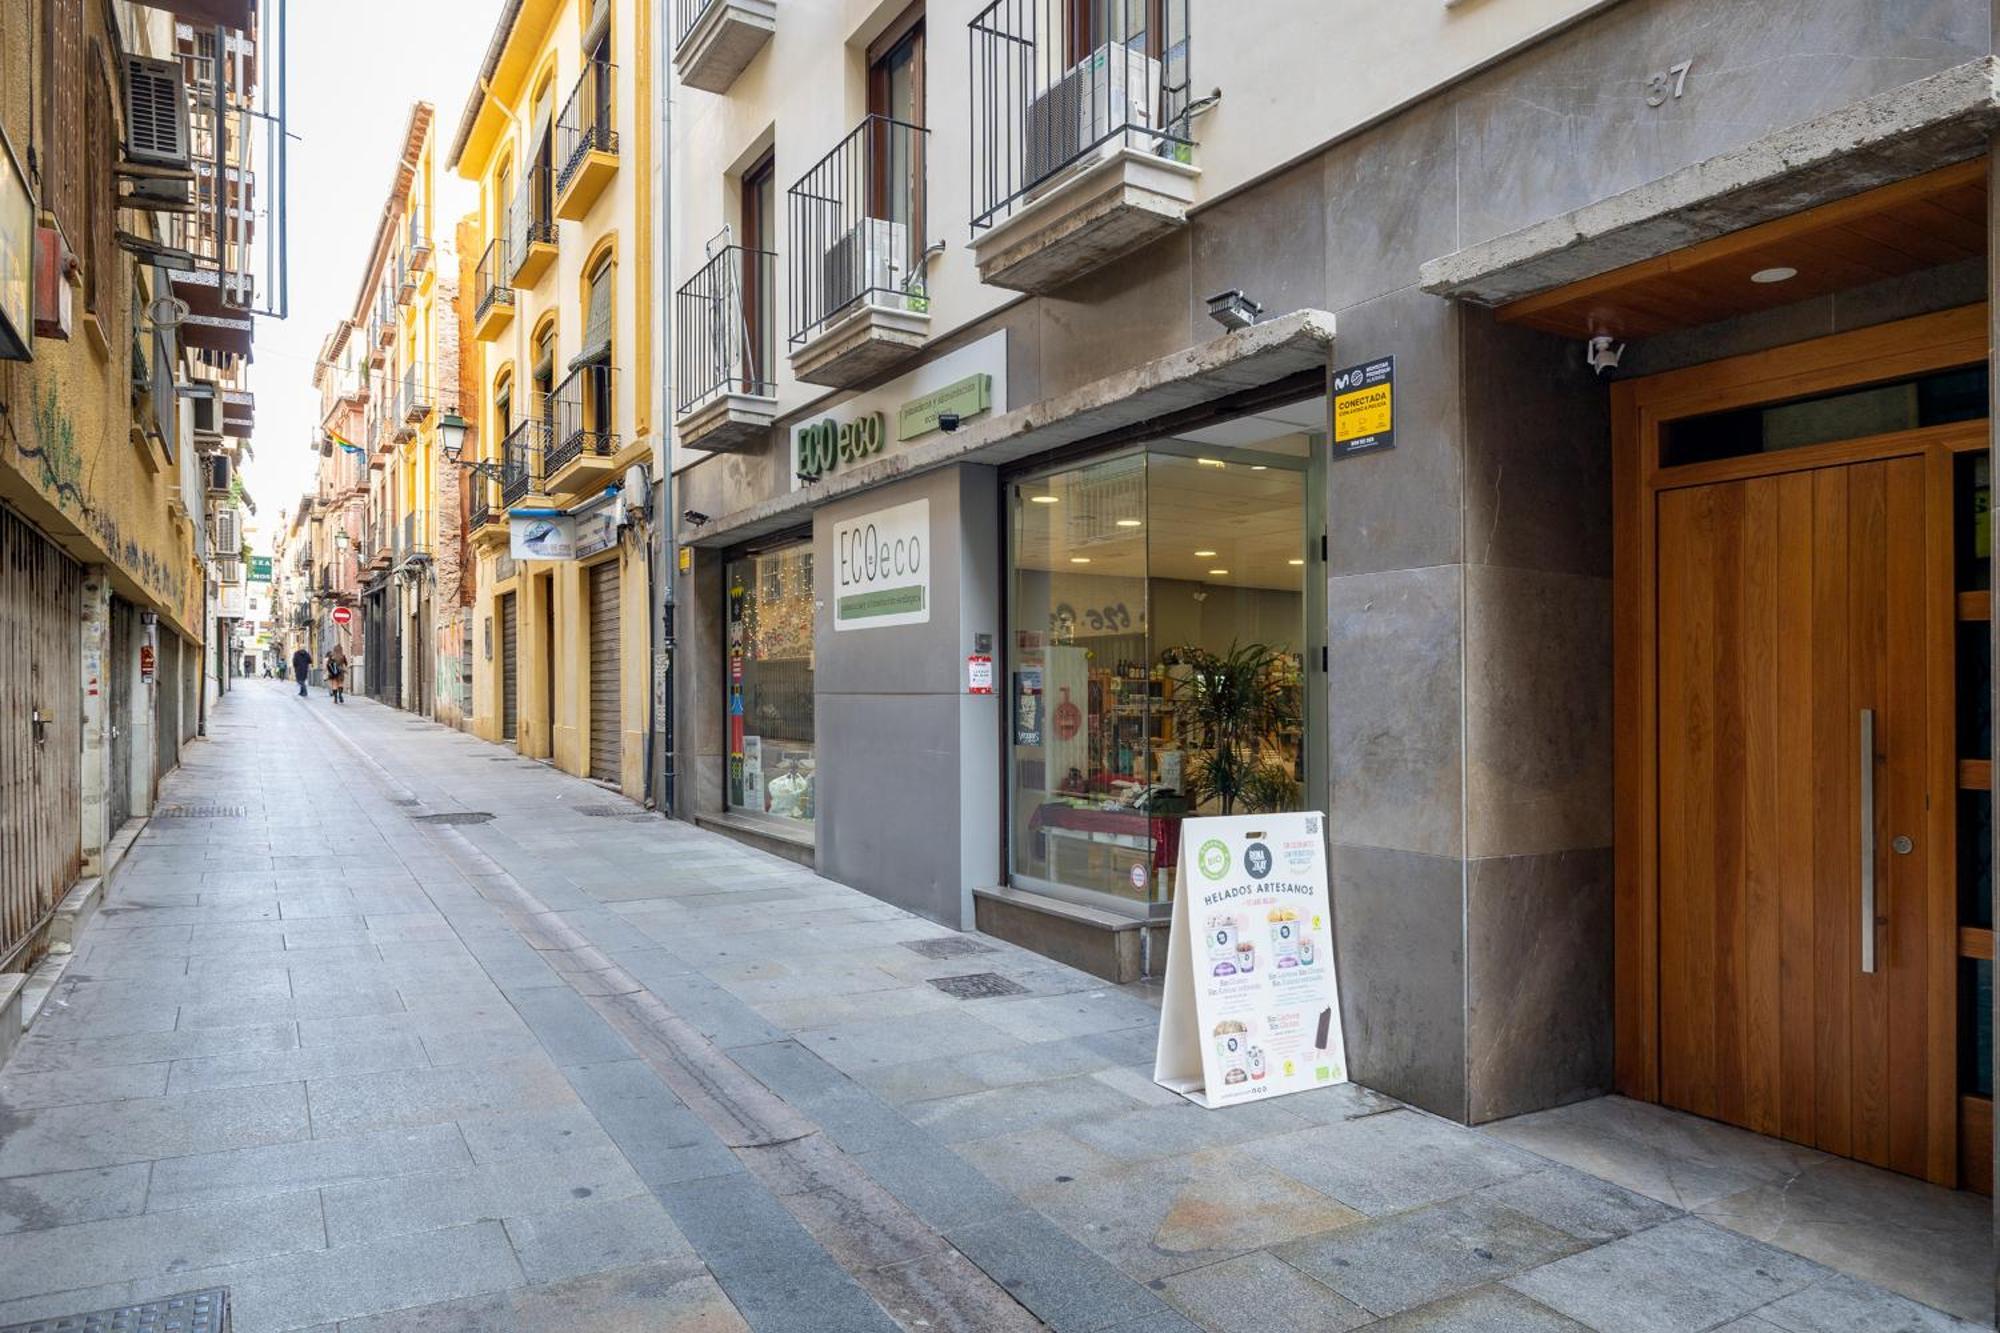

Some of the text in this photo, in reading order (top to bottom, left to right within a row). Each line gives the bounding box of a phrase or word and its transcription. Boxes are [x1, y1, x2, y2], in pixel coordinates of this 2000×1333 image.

[1647, 60, 1693, 107] 37
[1338, 392, 1387, 410] CONECTADA
[1204, 884, 1253, 906] HELADOS
[1256, 882, 1315, 896] ARTESANOS
